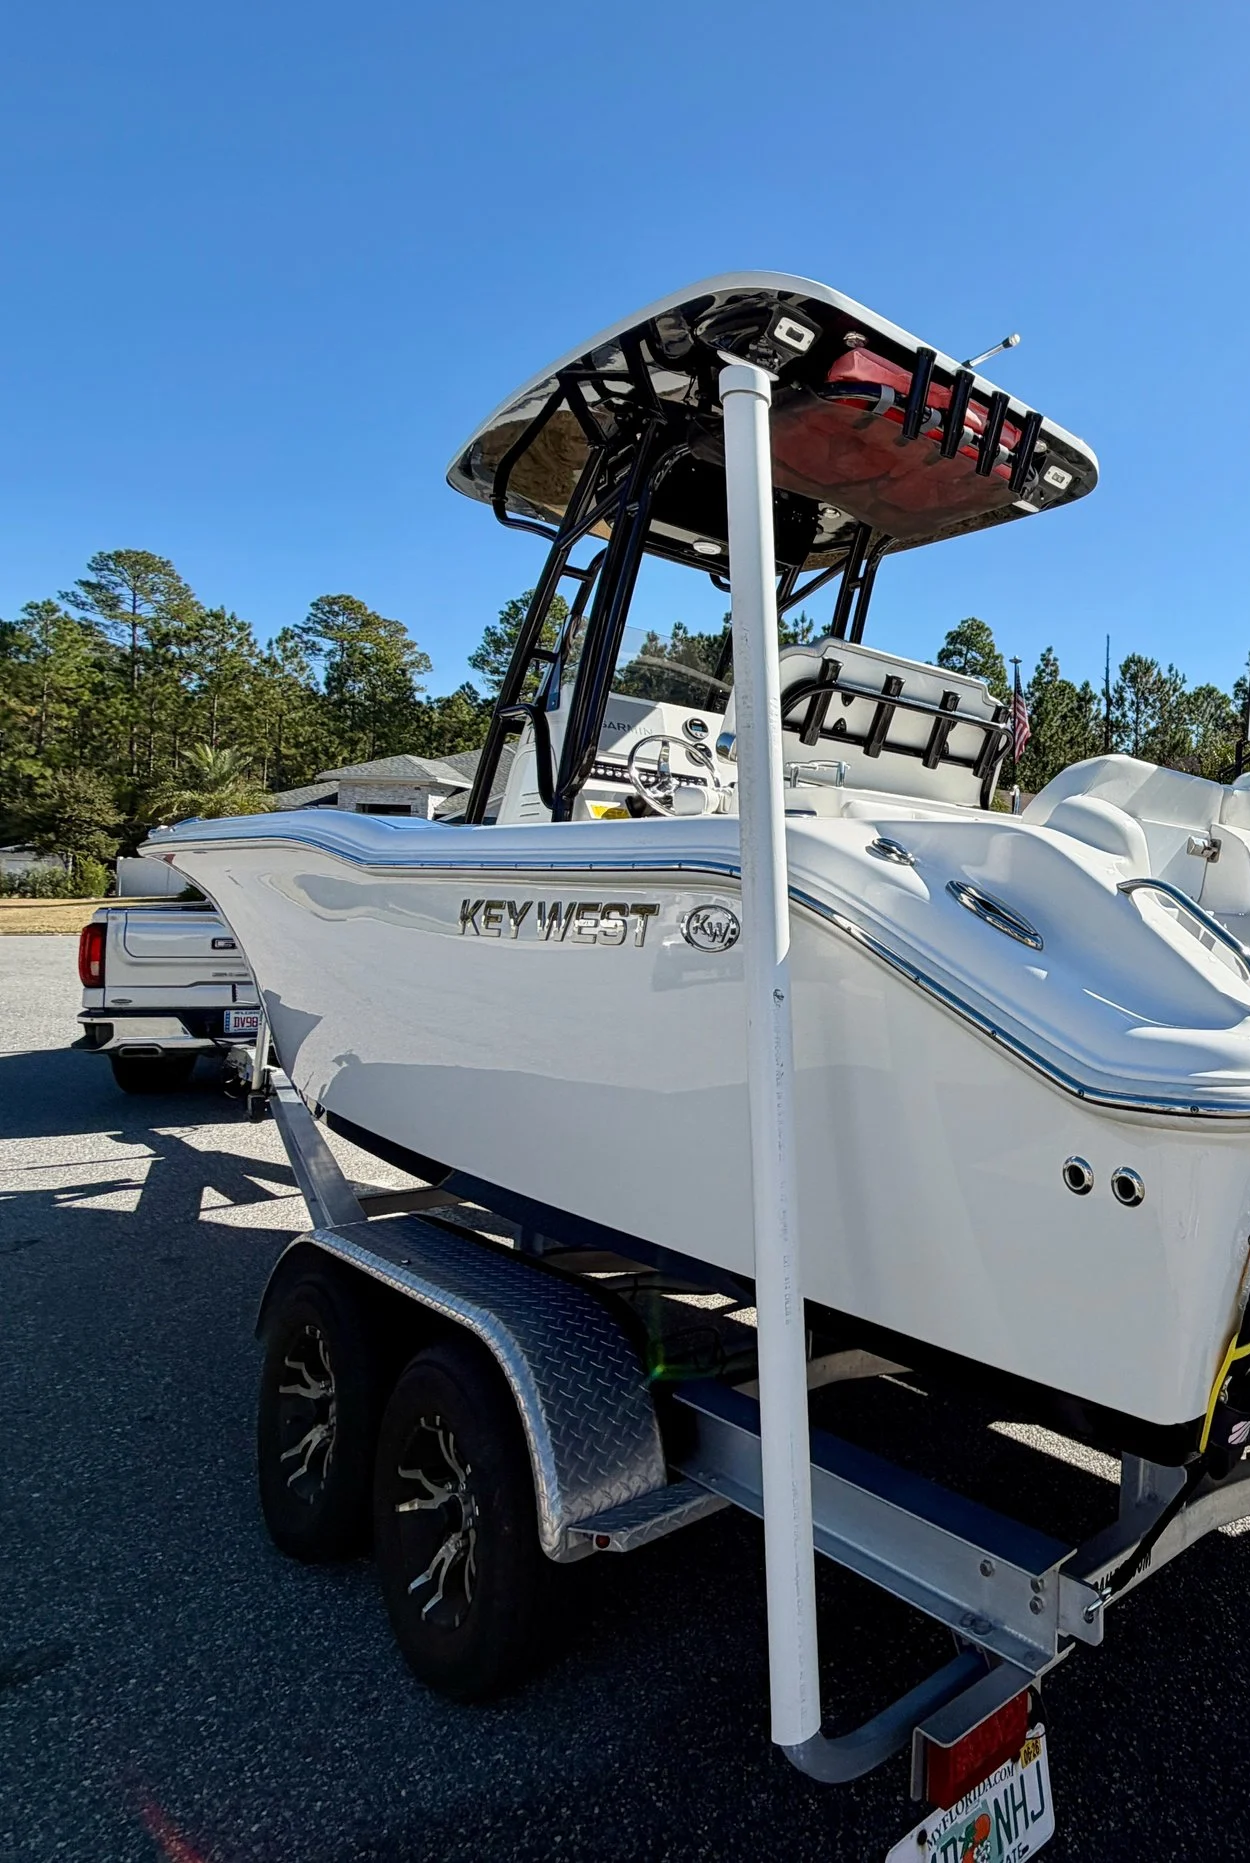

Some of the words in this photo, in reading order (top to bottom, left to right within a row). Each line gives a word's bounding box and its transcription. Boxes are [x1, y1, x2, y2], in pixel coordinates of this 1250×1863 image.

[458, 898, 534, 939] KEY
[537, 901, 661, 947] WEST
[692, 914, 730, 943] KW
[926, 1763, 1015, 1851] MYFLORIDA.COM
[993, 1760, 1045, 1856] NHJ
